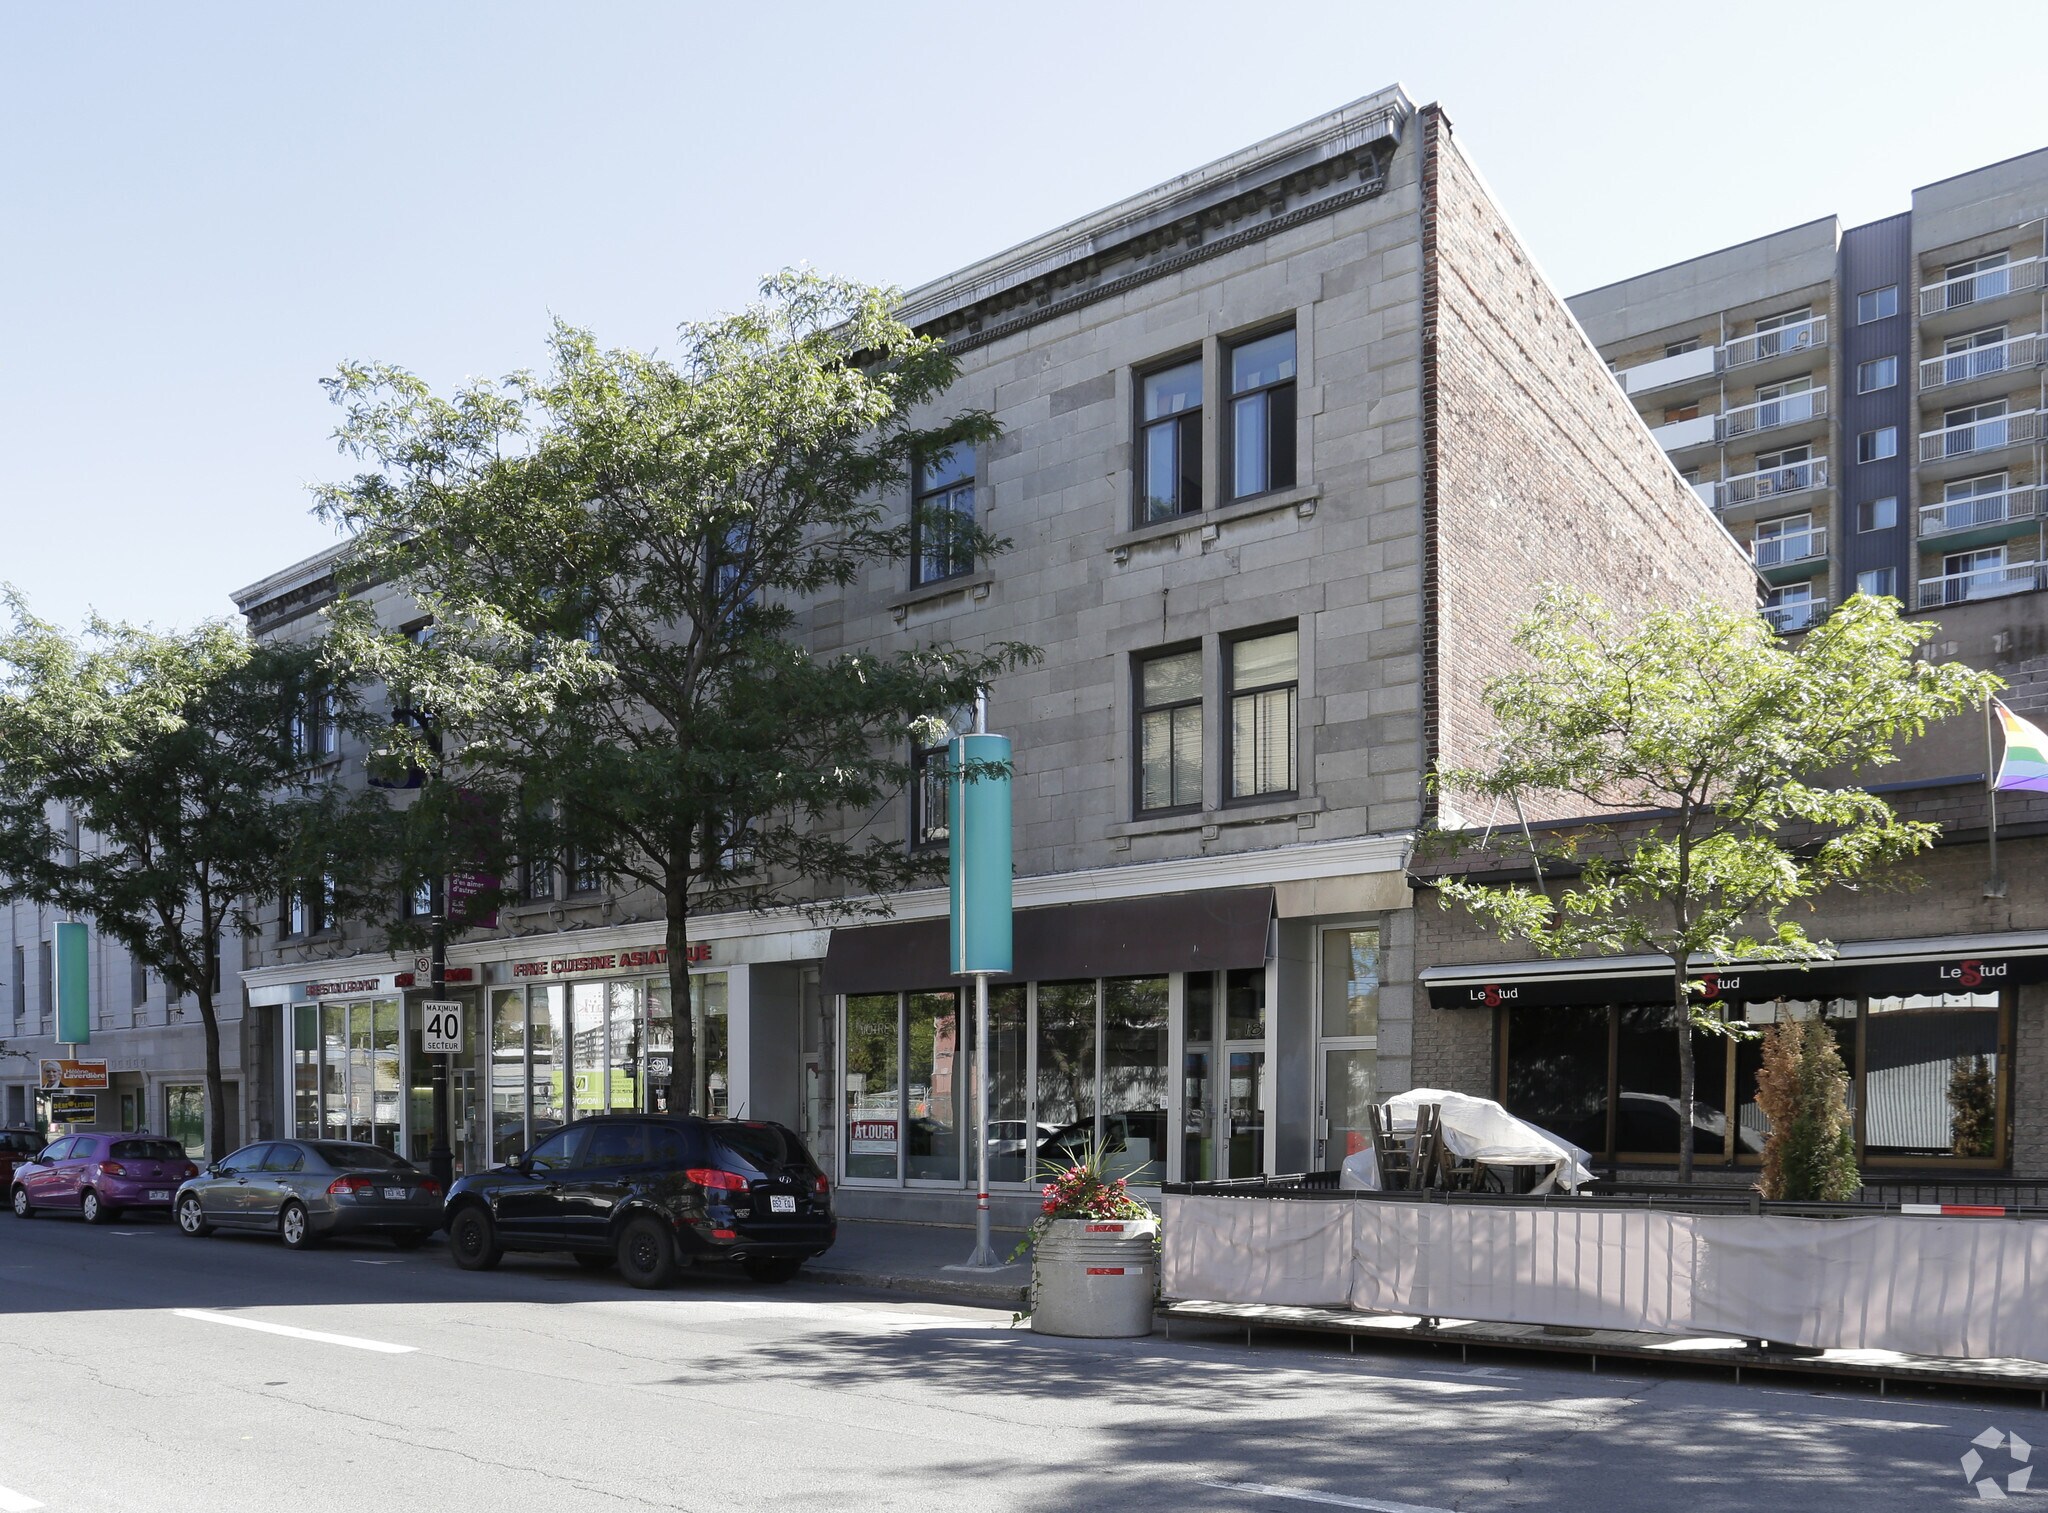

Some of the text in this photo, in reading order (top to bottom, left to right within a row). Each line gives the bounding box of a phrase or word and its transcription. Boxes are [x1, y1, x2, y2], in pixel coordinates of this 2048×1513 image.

[513, 945, 712, 977] FINE CUISINE ASIATUE
[305, 978, 380, 996] RESTAURANT
[426, 1004, 459, 1012] MAXIMUM
[427, 1013, 458, 1040] 40
[427, 1041, 458, 1050] SECTEUR
[854, 1121, 895, 1139] À LOUER
